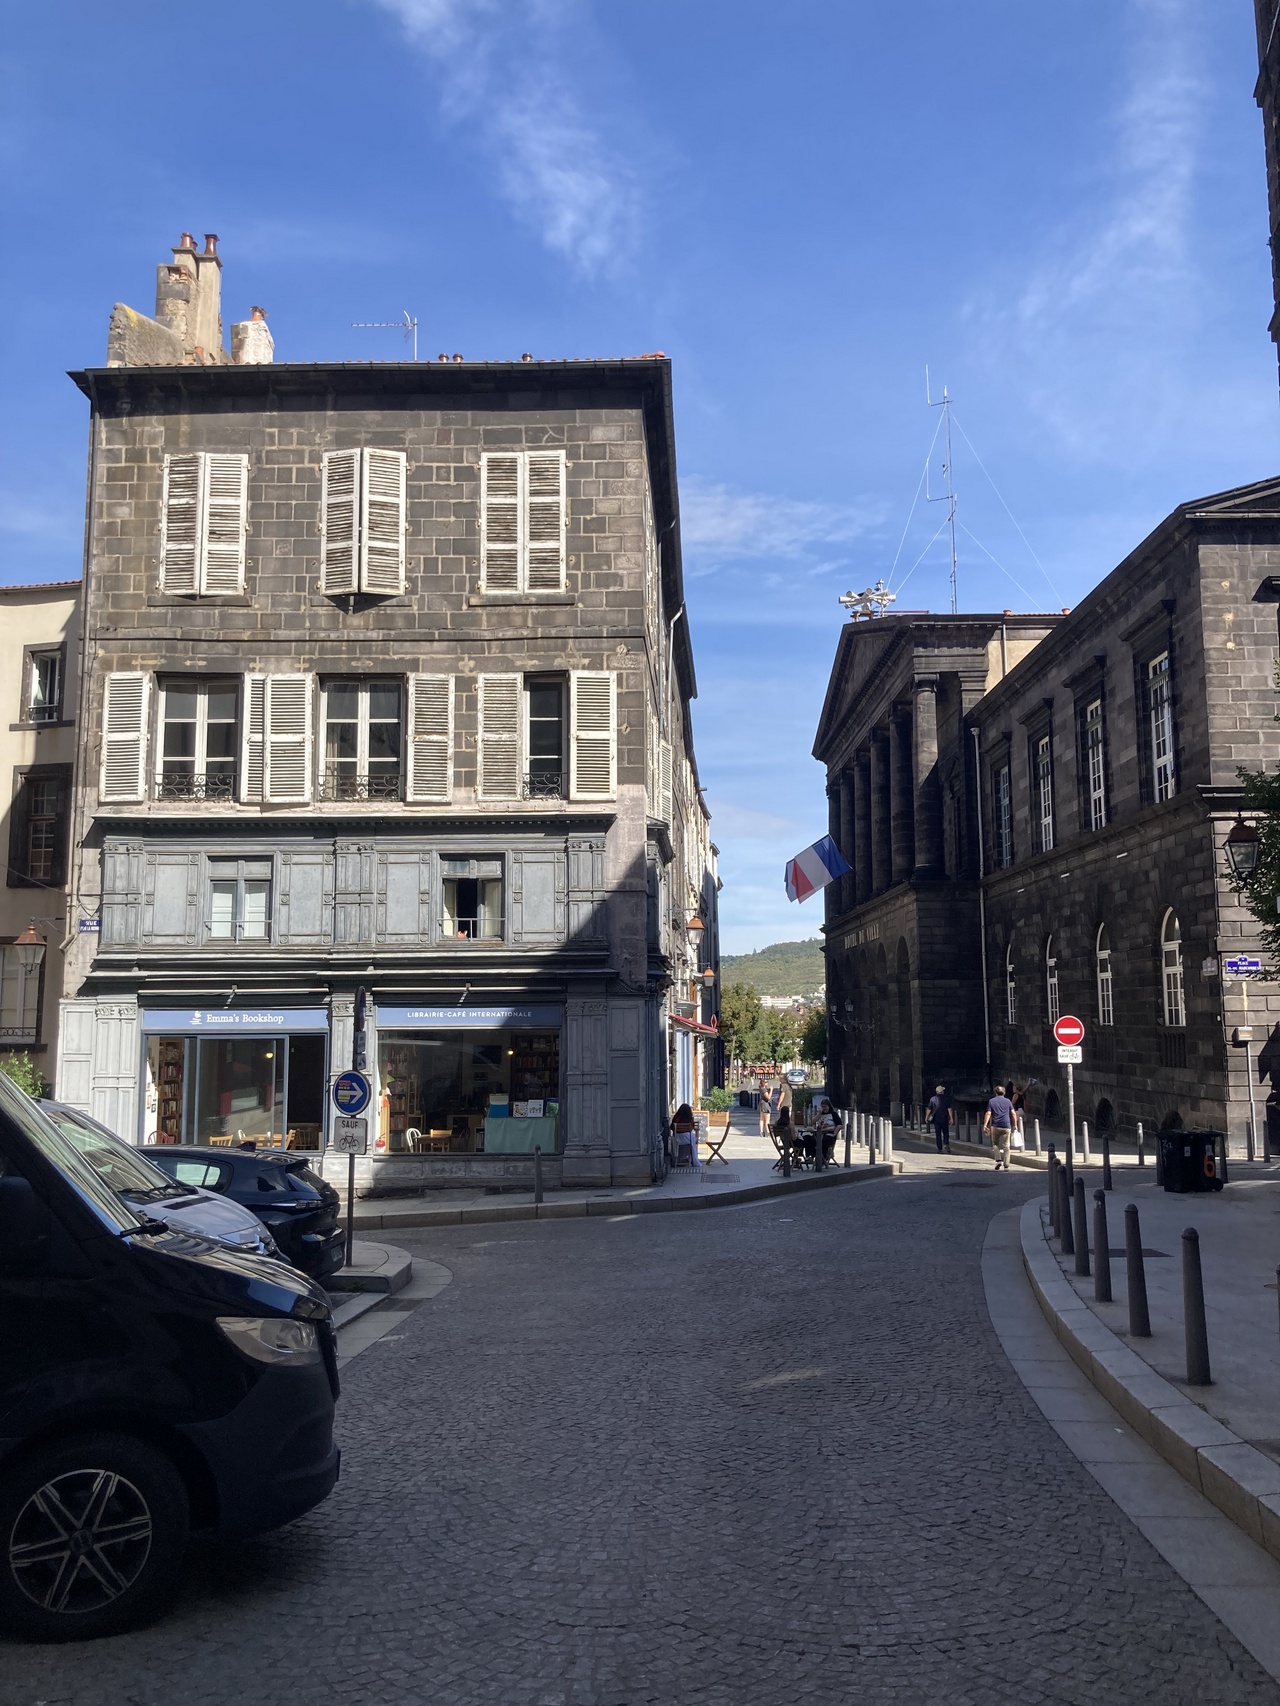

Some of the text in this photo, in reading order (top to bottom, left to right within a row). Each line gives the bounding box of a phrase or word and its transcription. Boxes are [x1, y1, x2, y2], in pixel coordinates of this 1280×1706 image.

[206, 1013, 284, 1024] Emma's Bookshop
[341, 1120, 359, 1129] SAUF
